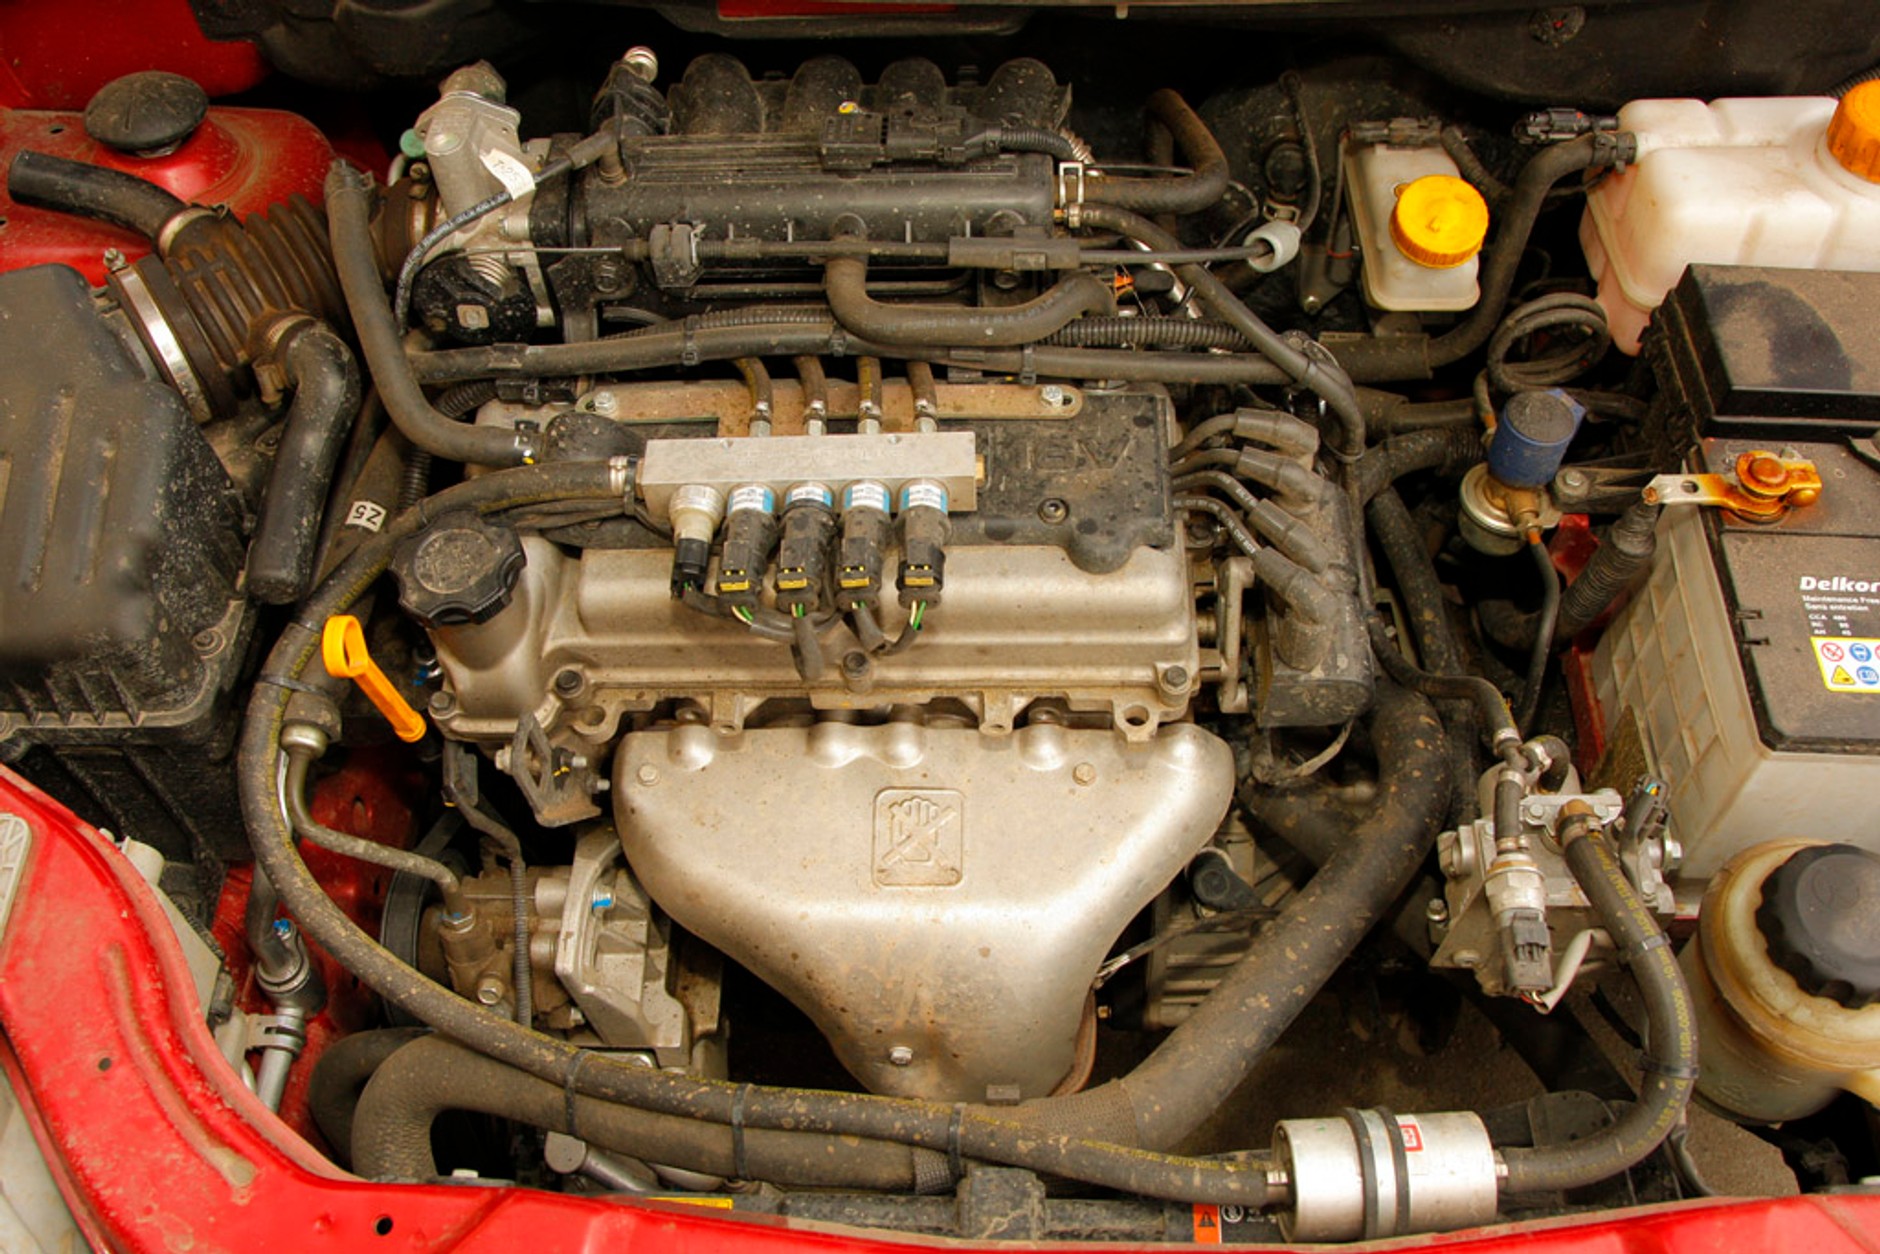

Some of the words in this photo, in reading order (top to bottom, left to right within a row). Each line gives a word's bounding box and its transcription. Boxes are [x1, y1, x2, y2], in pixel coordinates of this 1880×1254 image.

[353, 504, 382, 526] Z5
[1800, 576, 1880, 592] Delkor
[1802, 595, 1859, 603] Maintenance
